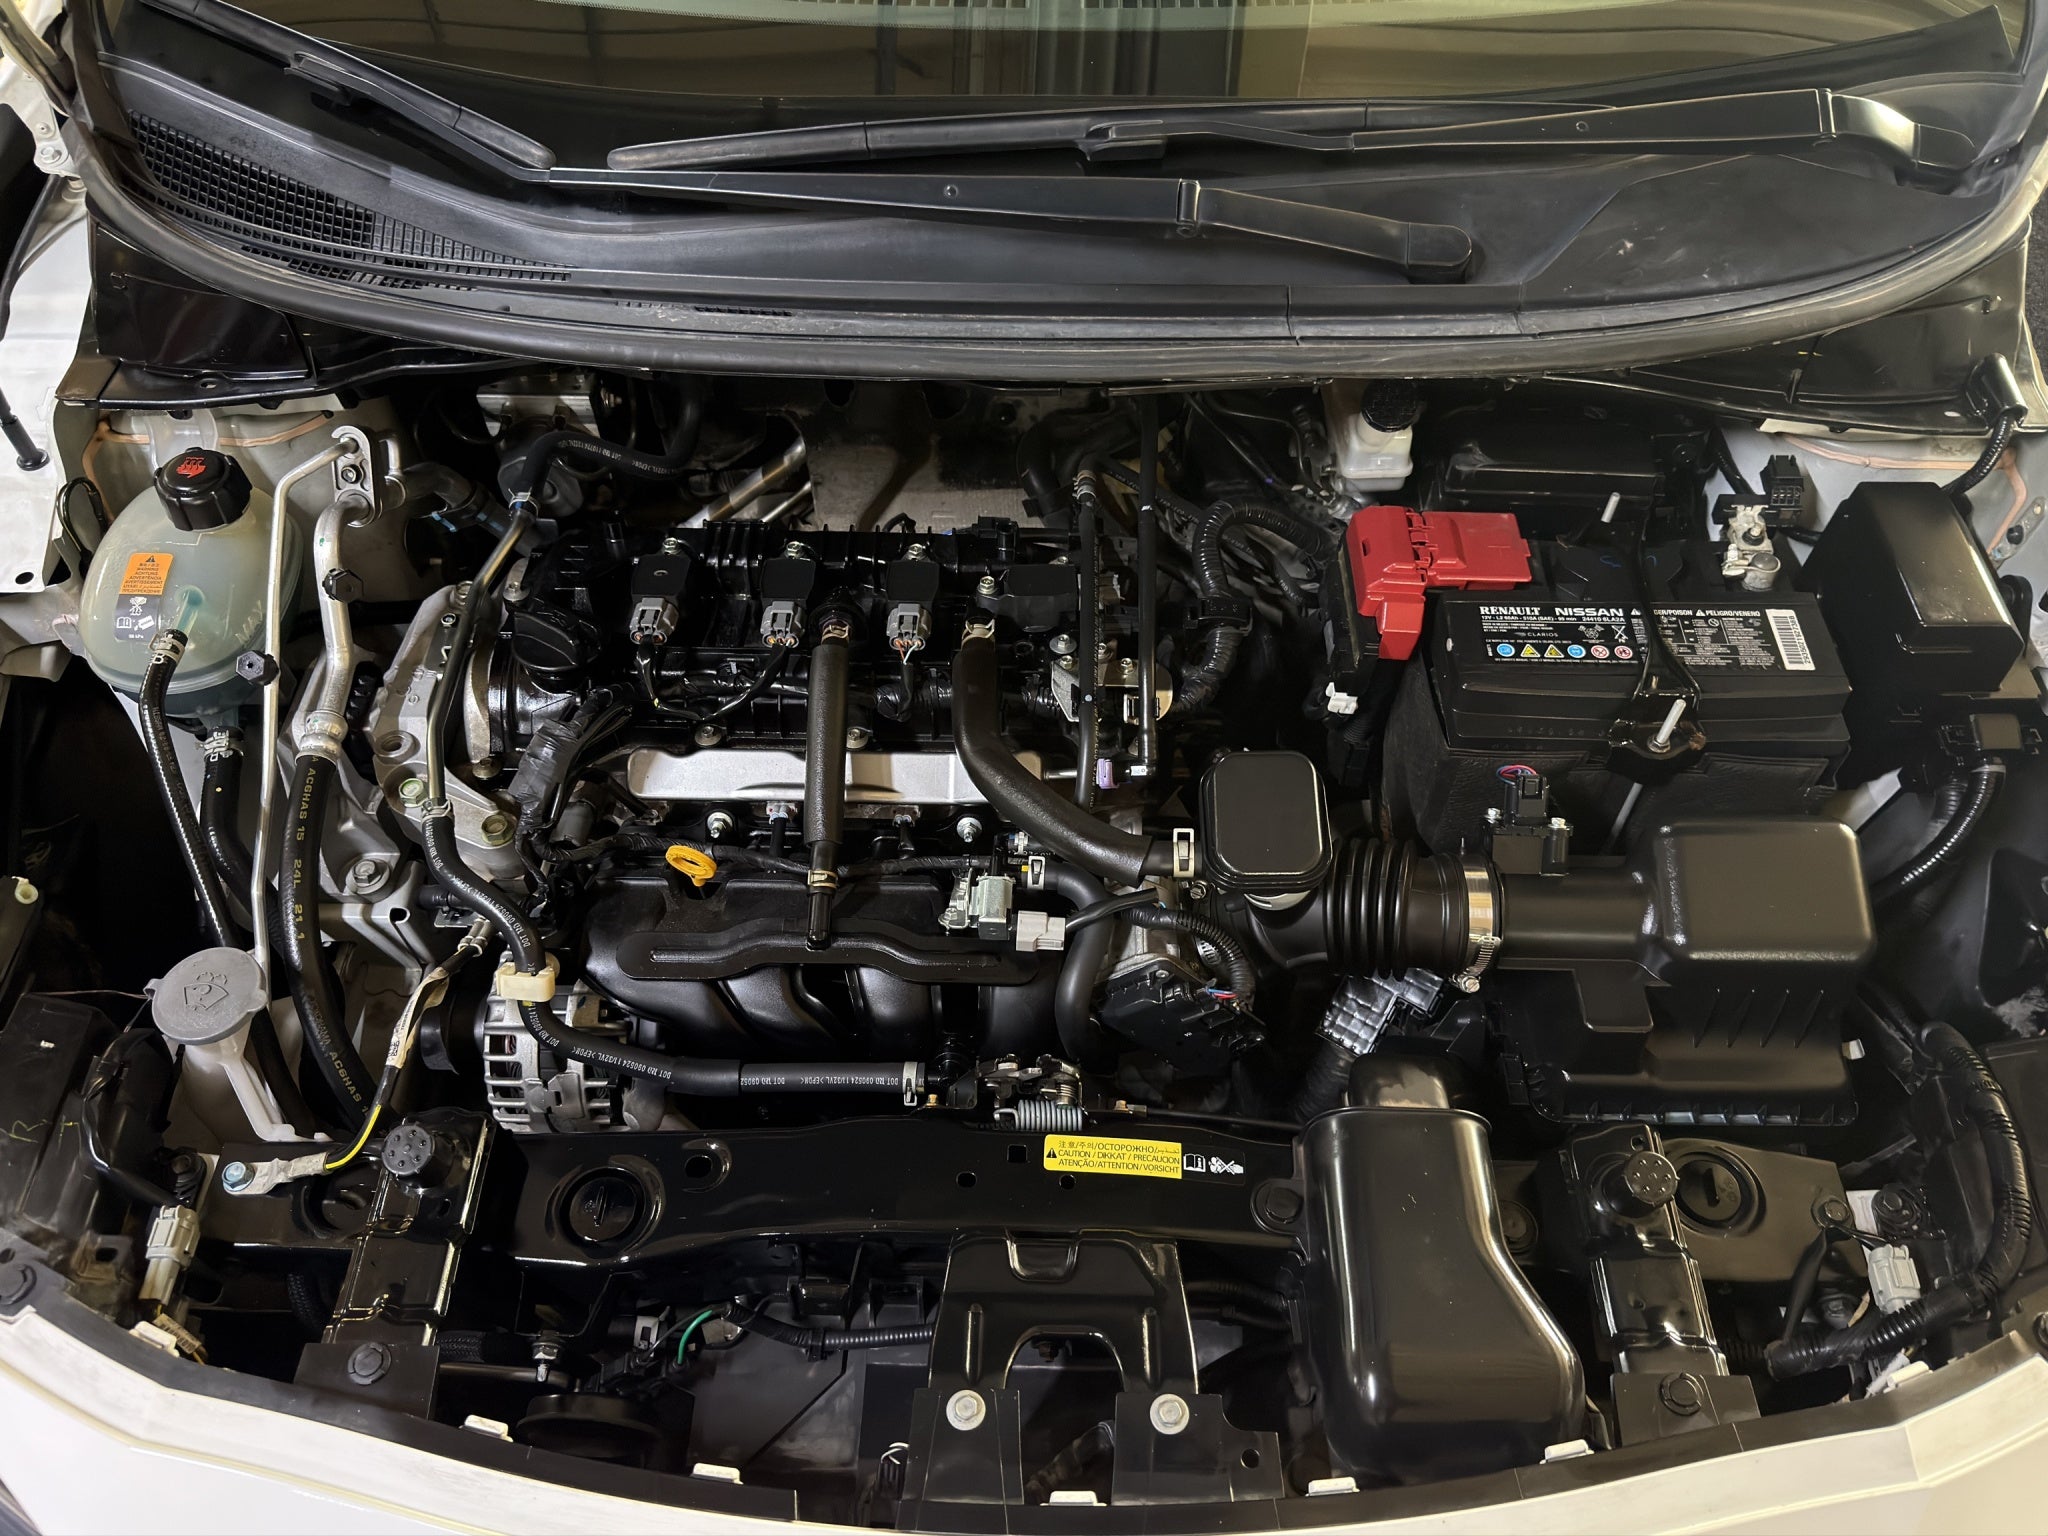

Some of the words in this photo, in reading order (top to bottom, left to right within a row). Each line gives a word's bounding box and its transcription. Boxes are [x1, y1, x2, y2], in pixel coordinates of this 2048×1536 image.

[1479, 606, 1541, 615] RENAULT
[1554, 607, 1624, 617] NISSAN
[296, 826, 305, 841] 15
[293, 859, 302, 889] 24L
[520, 933, 531, 948] DOT
[528, 1010, 543, 1036] 090524
[549, 1035, 560, 1047] DOT
[621, 1060, 646, 1073] 090524
[659, 1069, 672, 1080] DOT
[740, 1077, 760, 1086] 09052
[773, 1077, 785, 1085] DOT
[851, 1077, 873, 1085] 090524
[887, 1077, 899, 1086] DOT
[1058, 1149, 1091, 1158] CAUTION
[1097, 1151, 1126, 1160] DIKKAT
